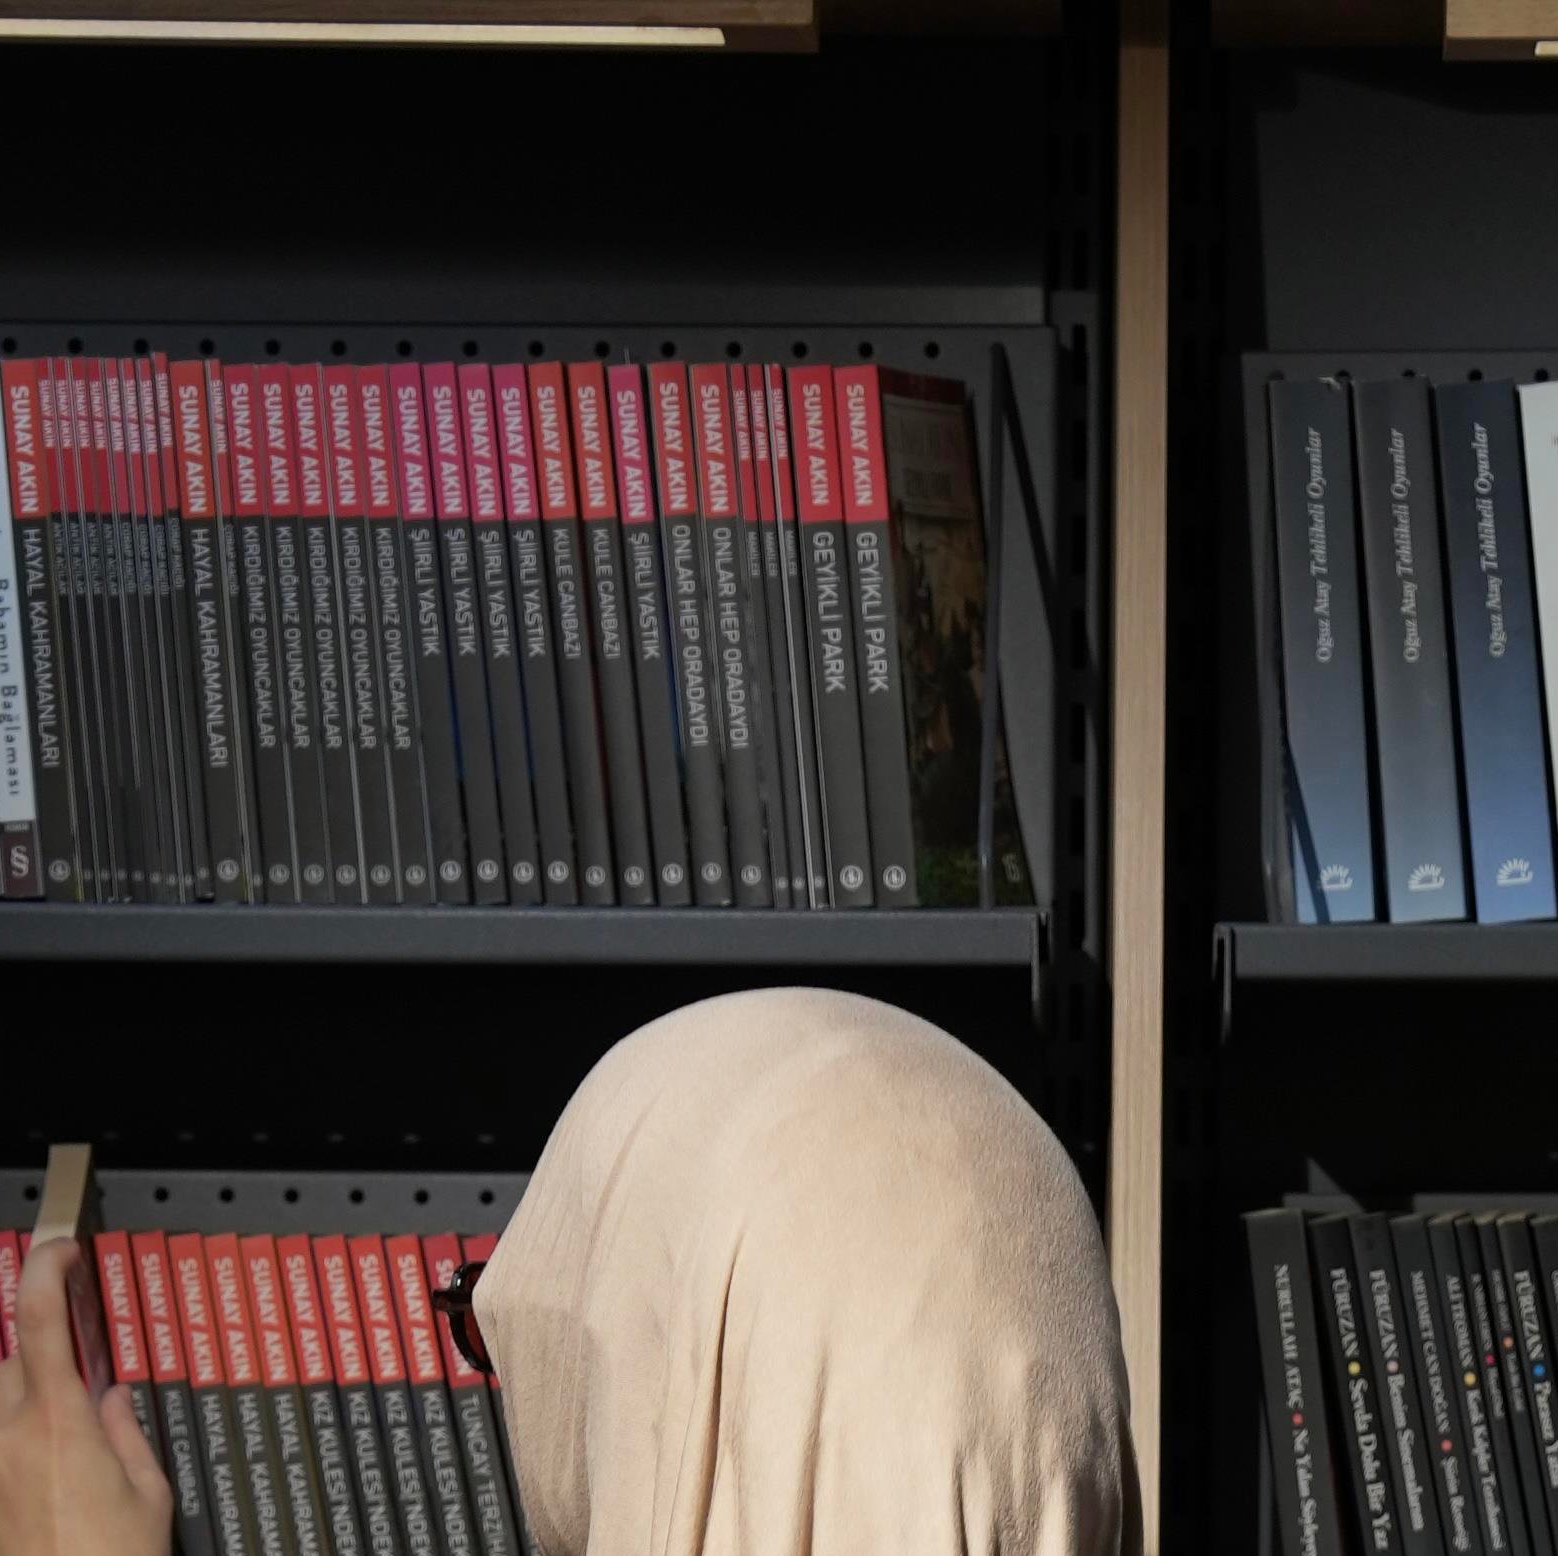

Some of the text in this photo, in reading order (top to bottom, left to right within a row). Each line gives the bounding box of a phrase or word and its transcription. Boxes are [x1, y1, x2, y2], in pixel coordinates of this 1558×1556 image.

[1472, 423, 1491, 493] Oyunlar
[701, 384, 749, 750] SUNAY AKIN ONLAR HEP ORADAYDI
[846, 384, 889, 693] SUNAY AKIN GEYİKLİ PARK
[1477, 498, 1500, 571] Tehlikeli
[397, 1253, 423, 1323] SUNAY
[409, 1326, 433, 1378] AKIN
[420, 1389, 445, 1425] KIZ
[459, 1393, 495, 1477] TUNCAY
